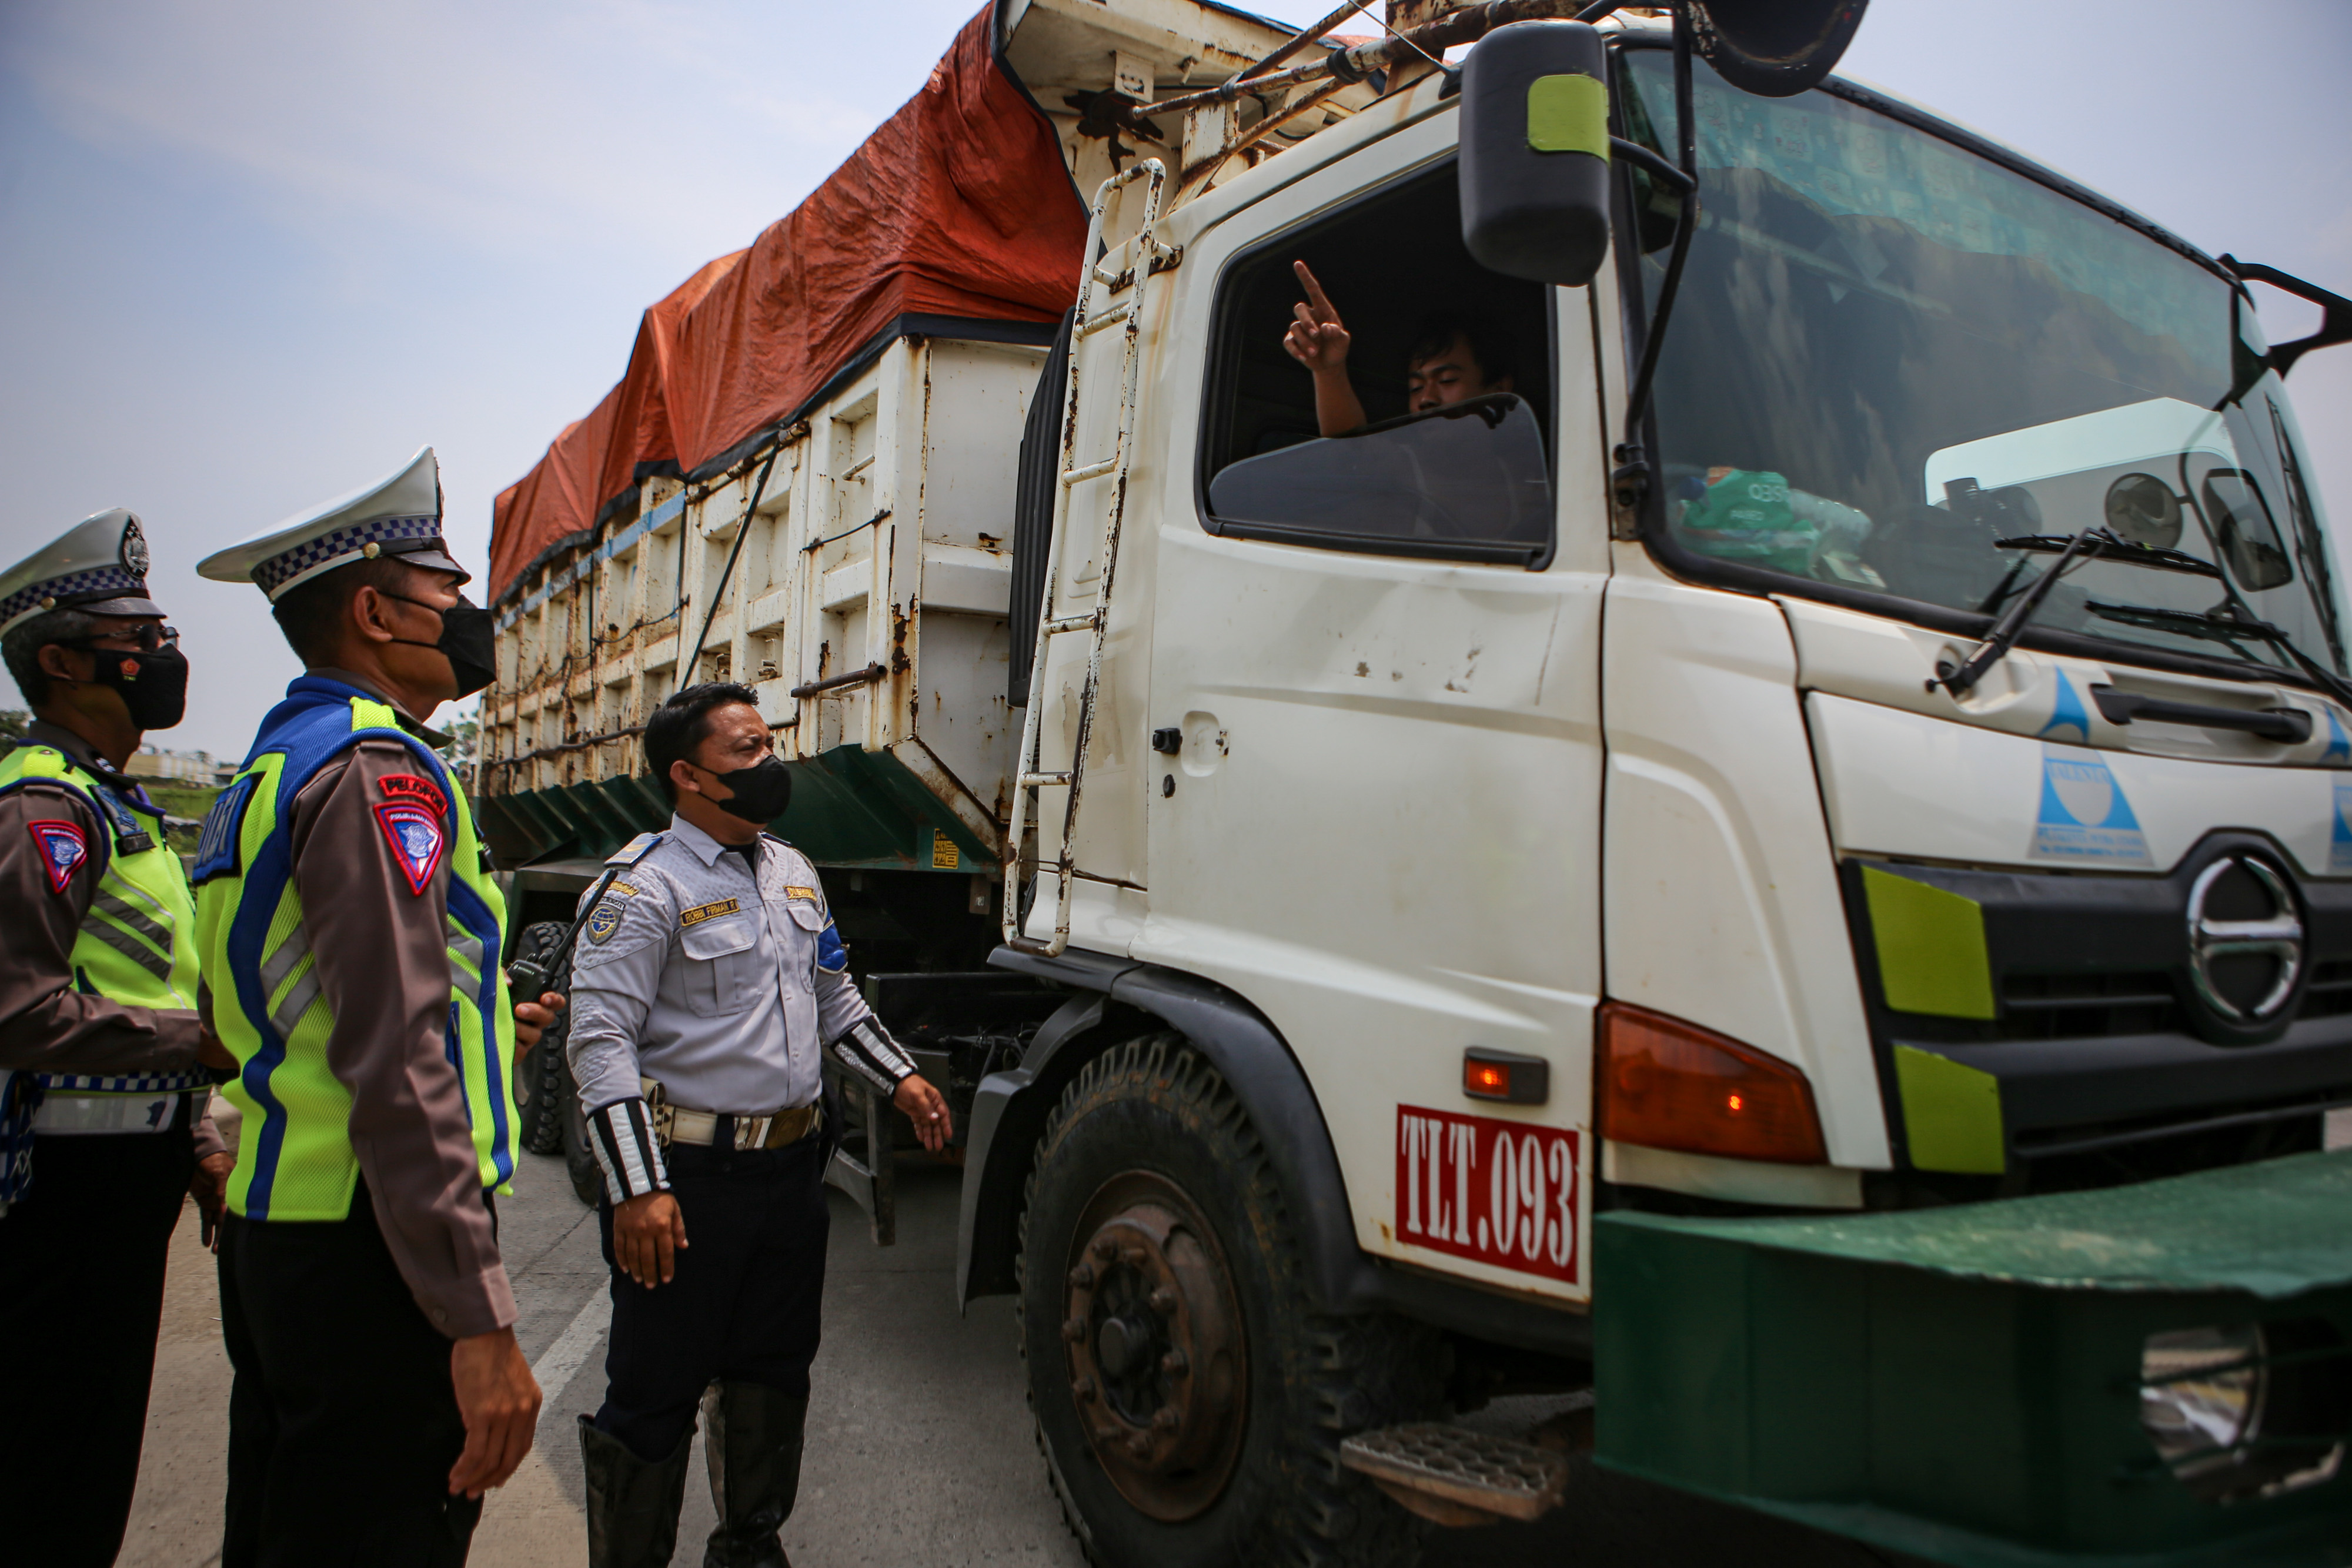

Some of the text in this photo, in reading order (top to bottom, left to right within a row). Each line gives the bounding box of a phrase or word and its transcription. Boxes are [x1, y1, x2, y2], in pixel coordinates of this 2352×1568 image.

[386, 779, 445, 809] PELOPOR
[684, 909, 706, 922] ROBBI
[706, 902, 729, 916] FIRMAN
[1402, 1114, 1573, 1268] TLT.093
